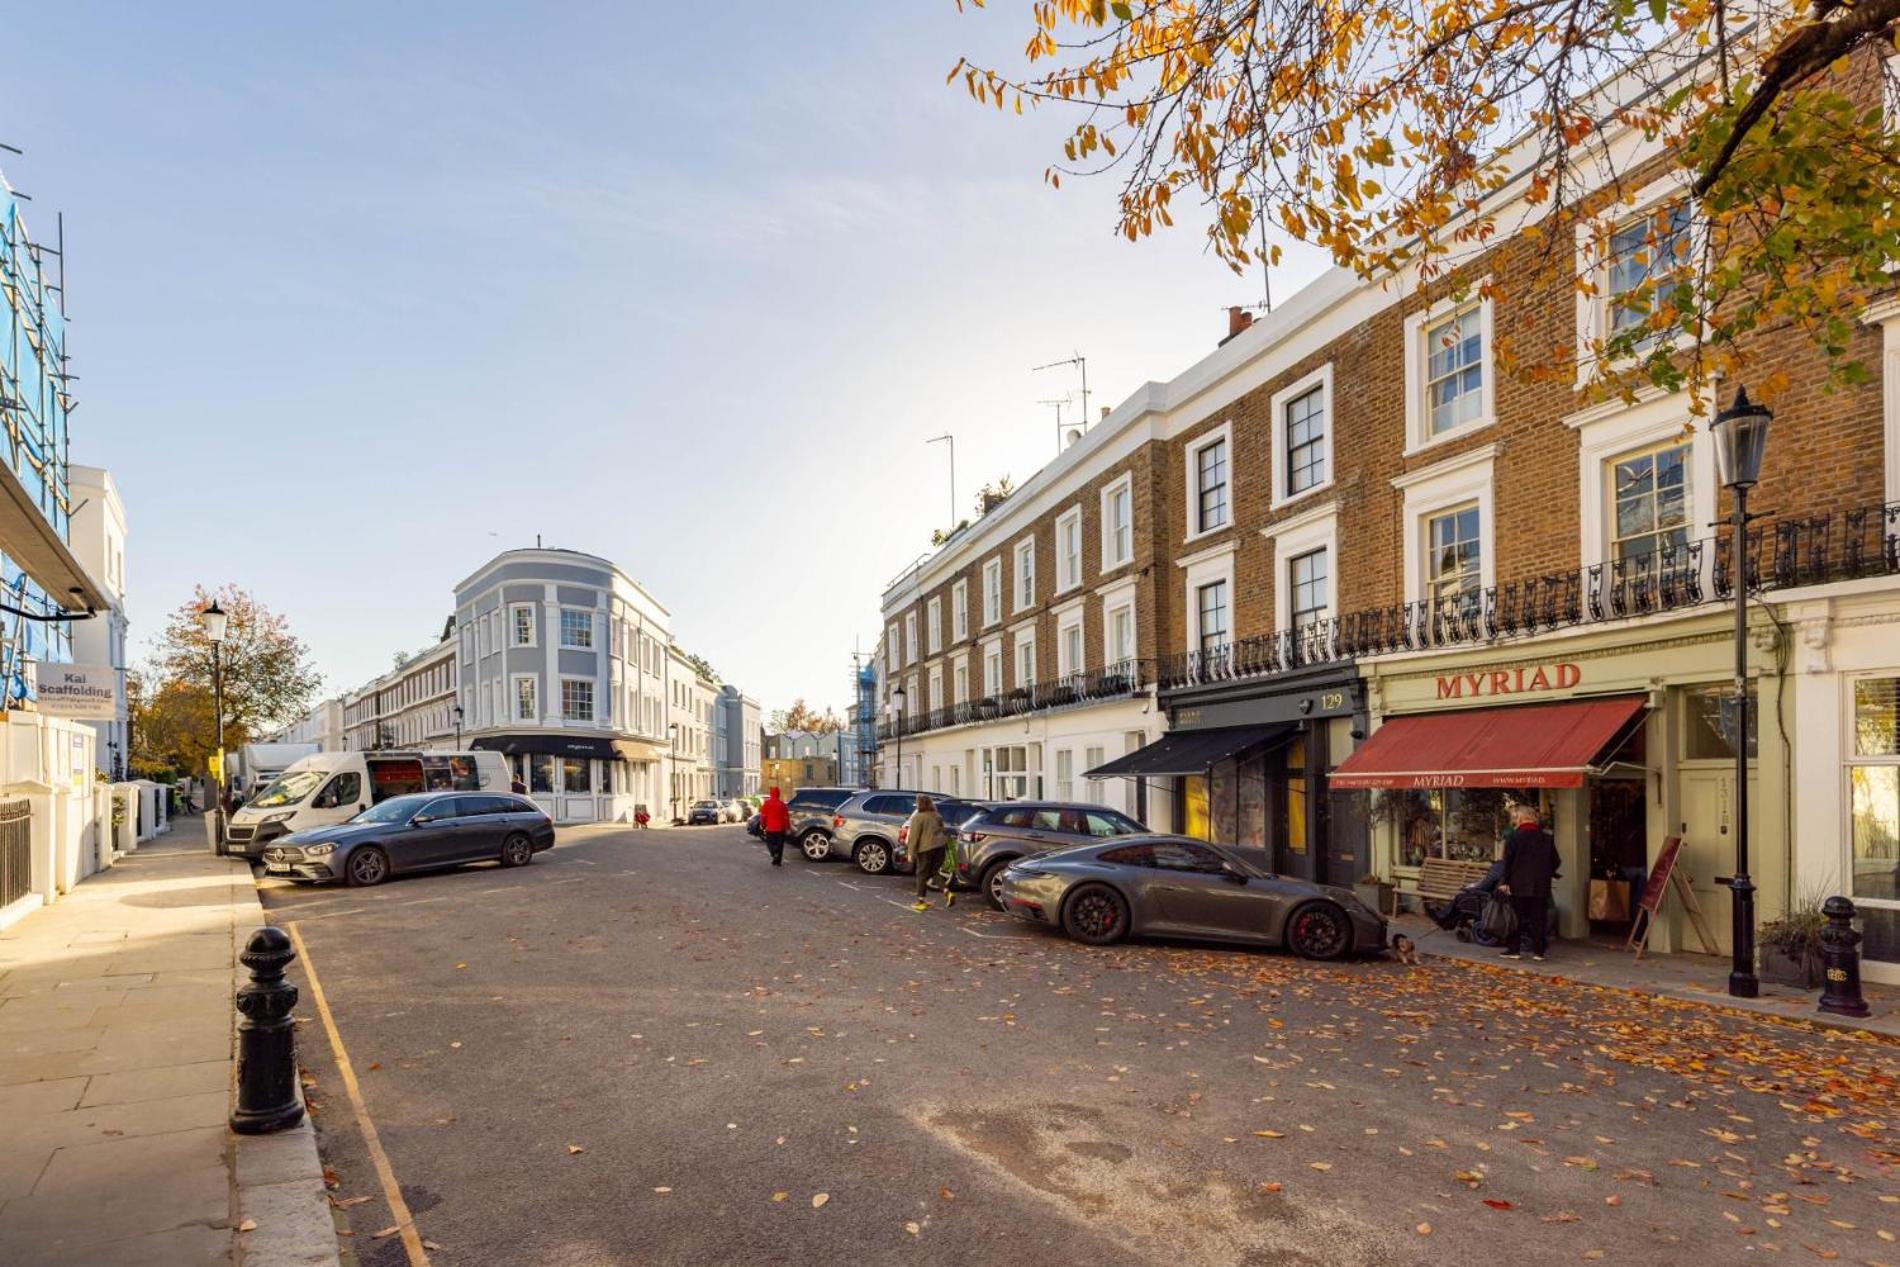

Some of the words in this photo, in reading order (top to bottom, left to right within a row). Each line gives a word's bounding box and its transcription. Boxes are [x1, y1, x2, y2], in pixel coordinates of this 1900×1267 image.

[64, 673, 86, 684] Kai
[1435, 663, 1581, 700] MYRIAD
[39, 684, 112, 698] Scaffolding
[1321, 694, 1343, 710] 129
[1413, 775, 1464, 788] MYRIAD
